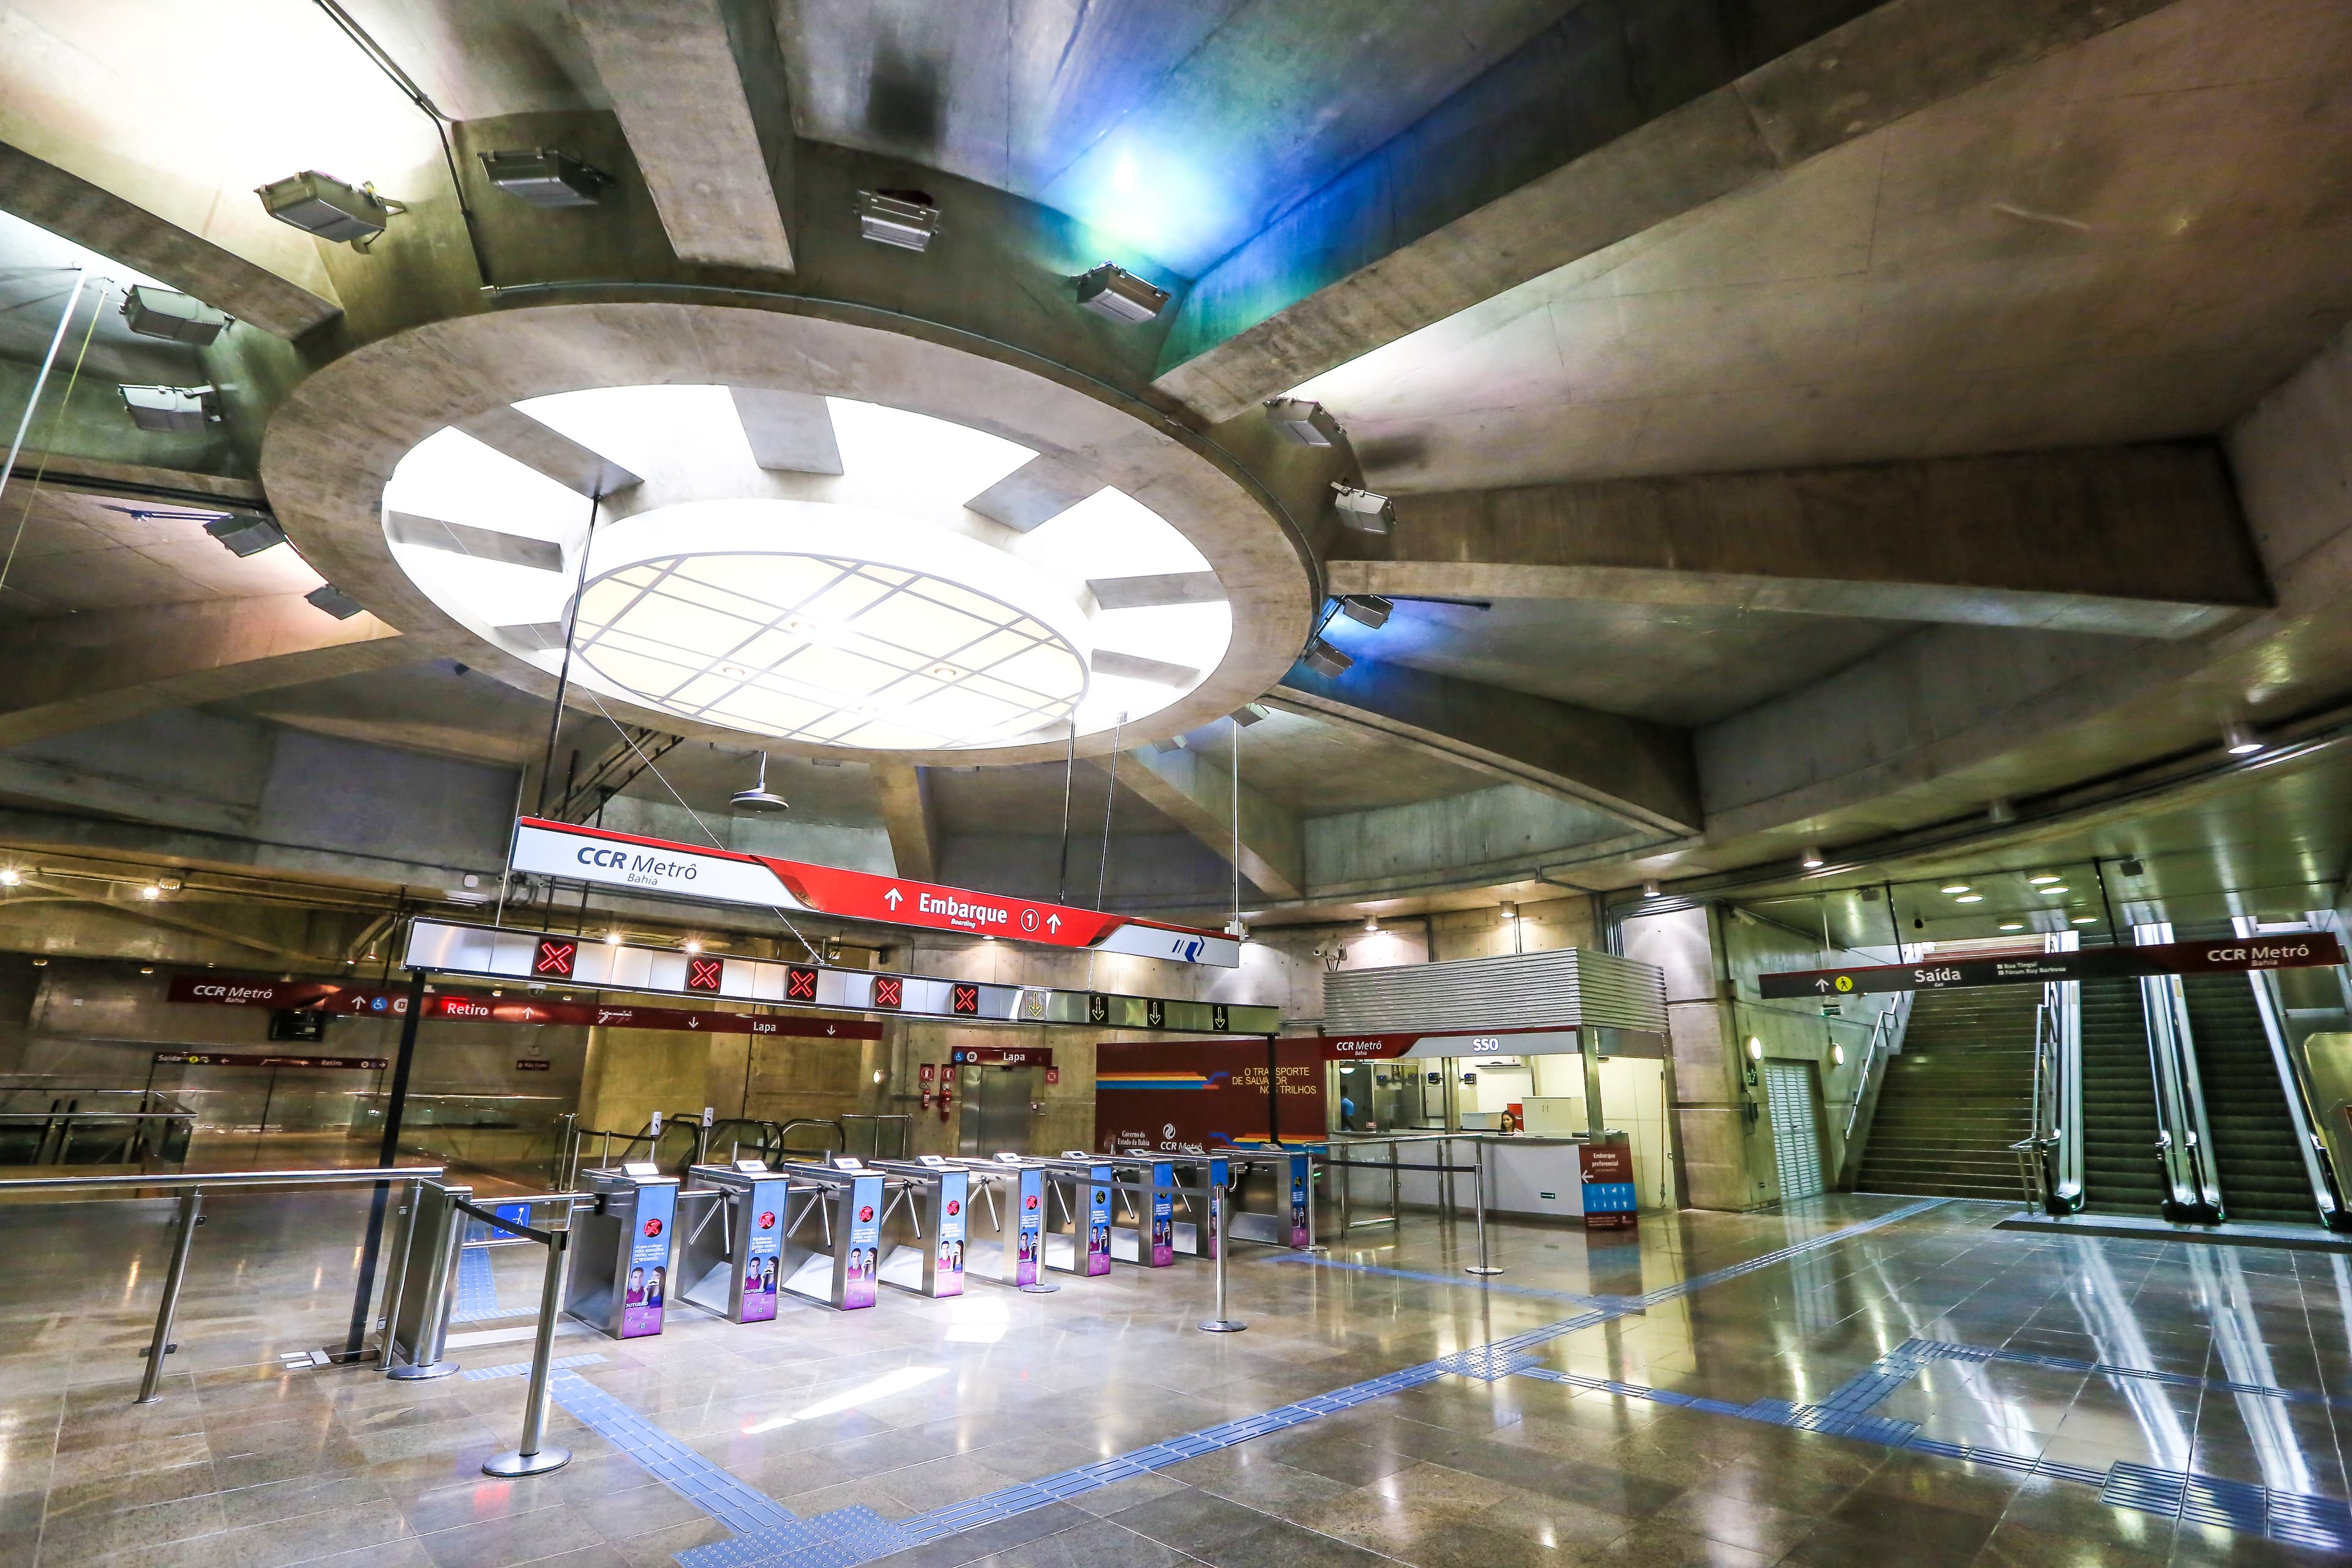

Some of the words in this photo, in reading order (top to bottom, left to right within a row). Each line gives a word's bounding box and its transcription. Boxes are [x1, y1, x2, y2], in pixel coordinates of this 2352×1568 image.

[577, 846, 627, 869] CCR
[631, 855, 697, 880] Metrô
[627, 873, 658, 886] Bahia
[918, 892, 1008, 926] Embarque
[950, 918, 977, 930] Boarding
[2207, 949, 2247, 962] CCR
[2251, 944, 2310, 959] Metrô
[1914, 968, 1961, 982] Saída
[194, 985, 226, 996] CCR
[228, 987, 273, 999] Metrô
[447, 1003, 489, 1016] Retiro
[753, 1021, 776, 1034] Lapa
[1336, 1041, 1354, 1051] CCR
[1355, 1040, 1382, 1050] Metrô
[1472, 1038, 1499, 1052] SSO
[1003, 1052, 1025, 1063] Lapa
[1244, 1068, 1251, 1076] O
[1253, 1067, 1310, 1076] TRASPORTE
[1245, 1076, 1288, 1085] SALVAOR
[1280, 1085, 1317, 1094] TRILHOS
[1160, 1141, 1177, 1150] CCR
